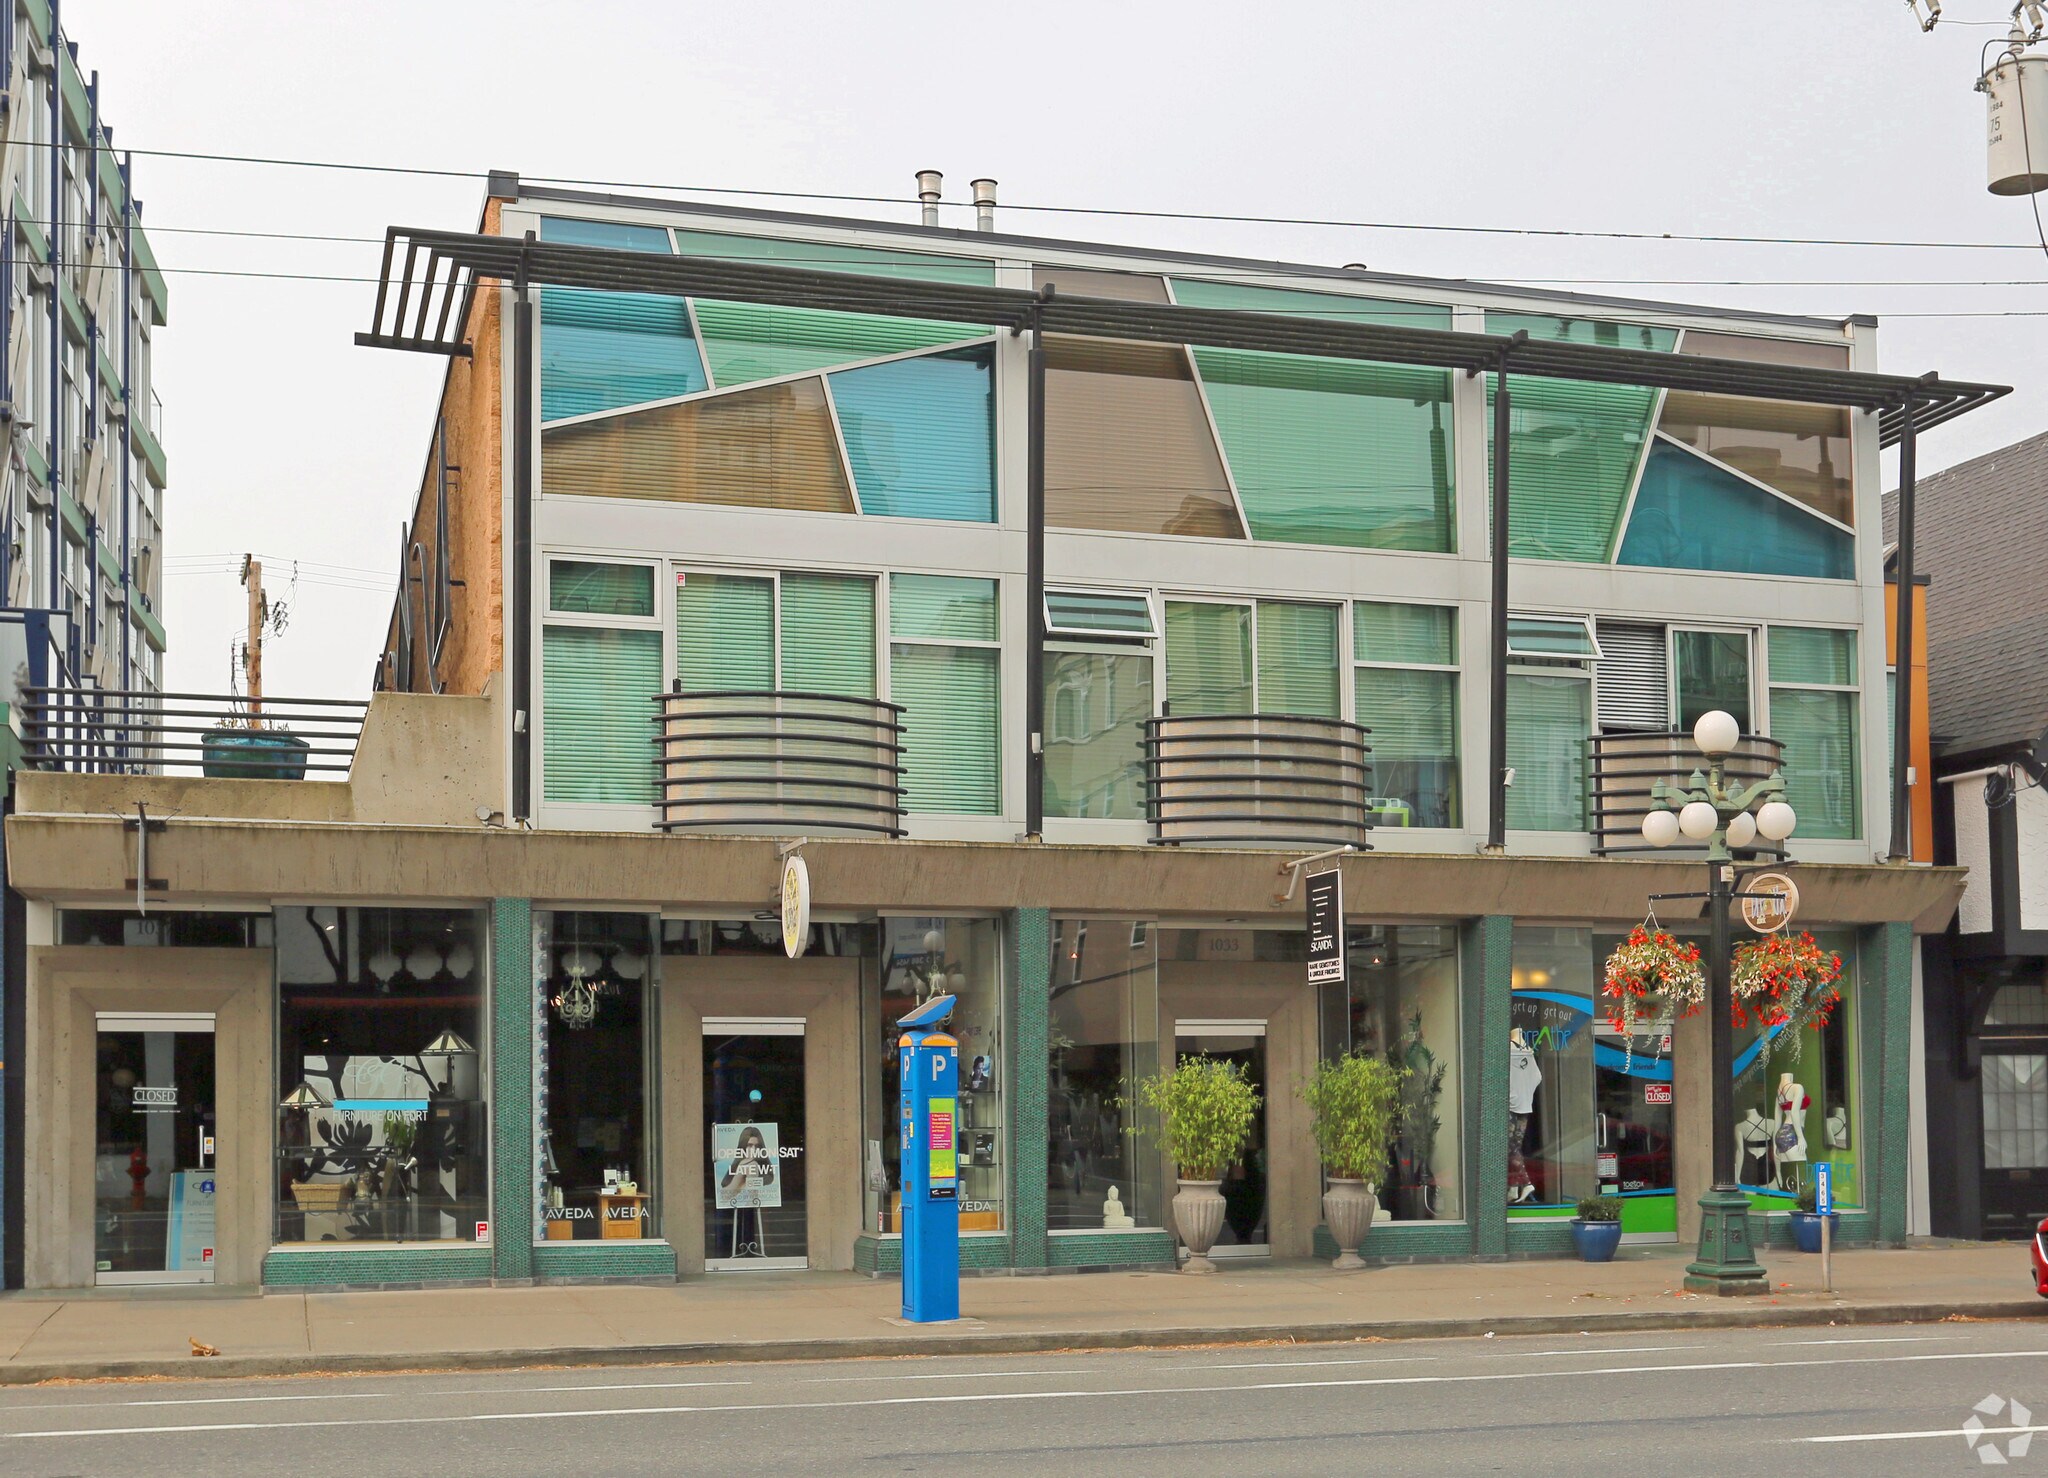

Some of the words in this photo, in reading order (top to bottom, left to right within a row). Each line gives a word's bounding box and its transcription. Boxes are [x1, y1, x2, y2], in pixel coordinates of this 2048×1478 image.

[1310, 940, 1333, 953] SKANDA
[1512, 1002, 1526, 1016] get
[1543, 1007, 1557, 1020] get
[932, 1055, 947, 1081] P
[134, 1090, 176, 1102] CLOSED
[1646, 1092, 1671, 1102] CLOSED
[333, 1110, 383, 1121] FURNITURE
[386, 1110, 402, 1121] ON
[404, 1110, 428, 1121] FORT
[718, 1148, 749, 1159] OPEN
[728, 1165, 757, 1176] LATE
[957, 1201, 992, 1212] VEDA
[546, 1208, 594, 1219] AVEDA
[602, 1207, 650, 1218] AVEDA
